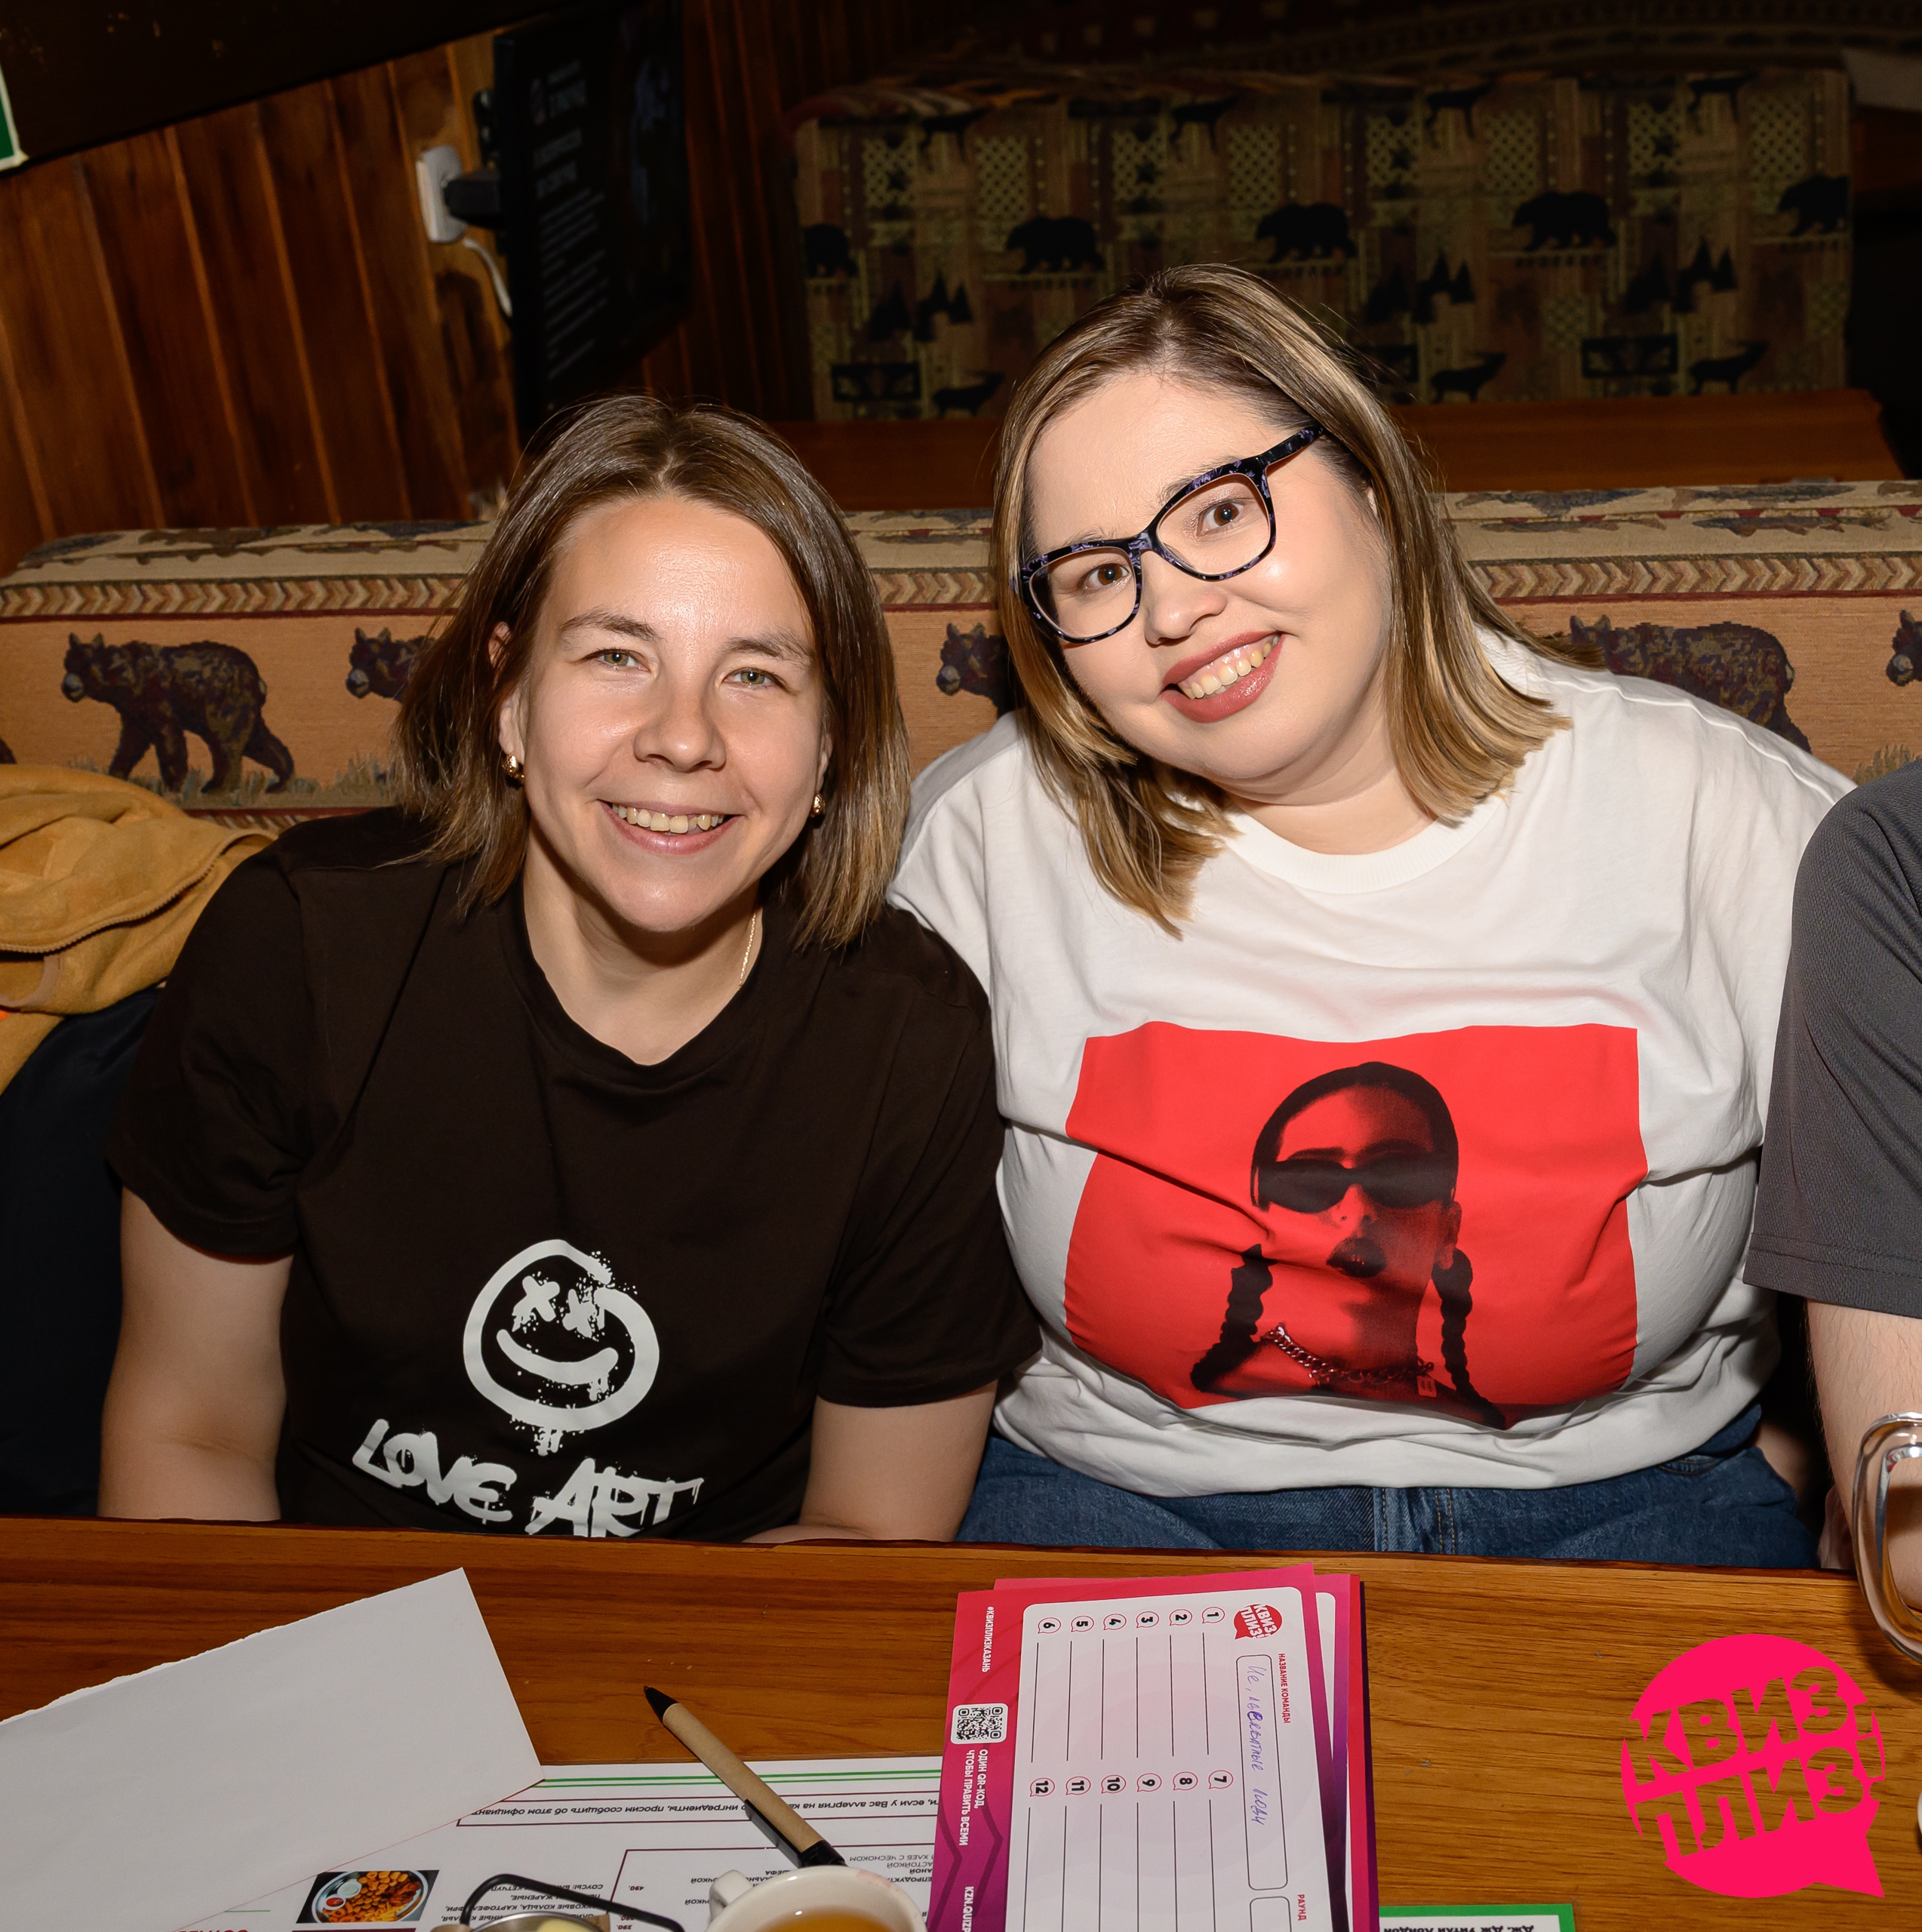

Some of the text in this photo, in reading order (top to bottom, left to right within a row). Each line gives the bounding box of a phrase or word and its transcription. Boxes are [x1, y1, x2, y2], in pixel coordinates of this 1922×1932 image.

[352, 1418, 705, 1538] LOVE ART
[981, 1606, 995, 1672] #КВИЗПЛИЗКАЗАНЬ
[1278, 1653, 1290, 1724] НАЗВАНИЕ КОМАНДЫ
[973, 1749, 989, 1809] ОДИН QR-КОД,
[1035, 1780, 1049, 1794] 12
[1072, 1780, 1085, 1792] 11
[1107, 1777, 1120, 1792] 10
[1179, 1777, 1192, 1786] 8
[667, 1804, 739, 1813] ингредиенты,
[818, 1801, 866, 1809] аллергия
[958, 1749, 975, 1846] ЧТОБЫ ПРАВИТЬ ВСЕМИ
[961, 1887, 974, 1932] KZN.QUIZP
[1297, 1894, 1307, 1921] РАУНД
